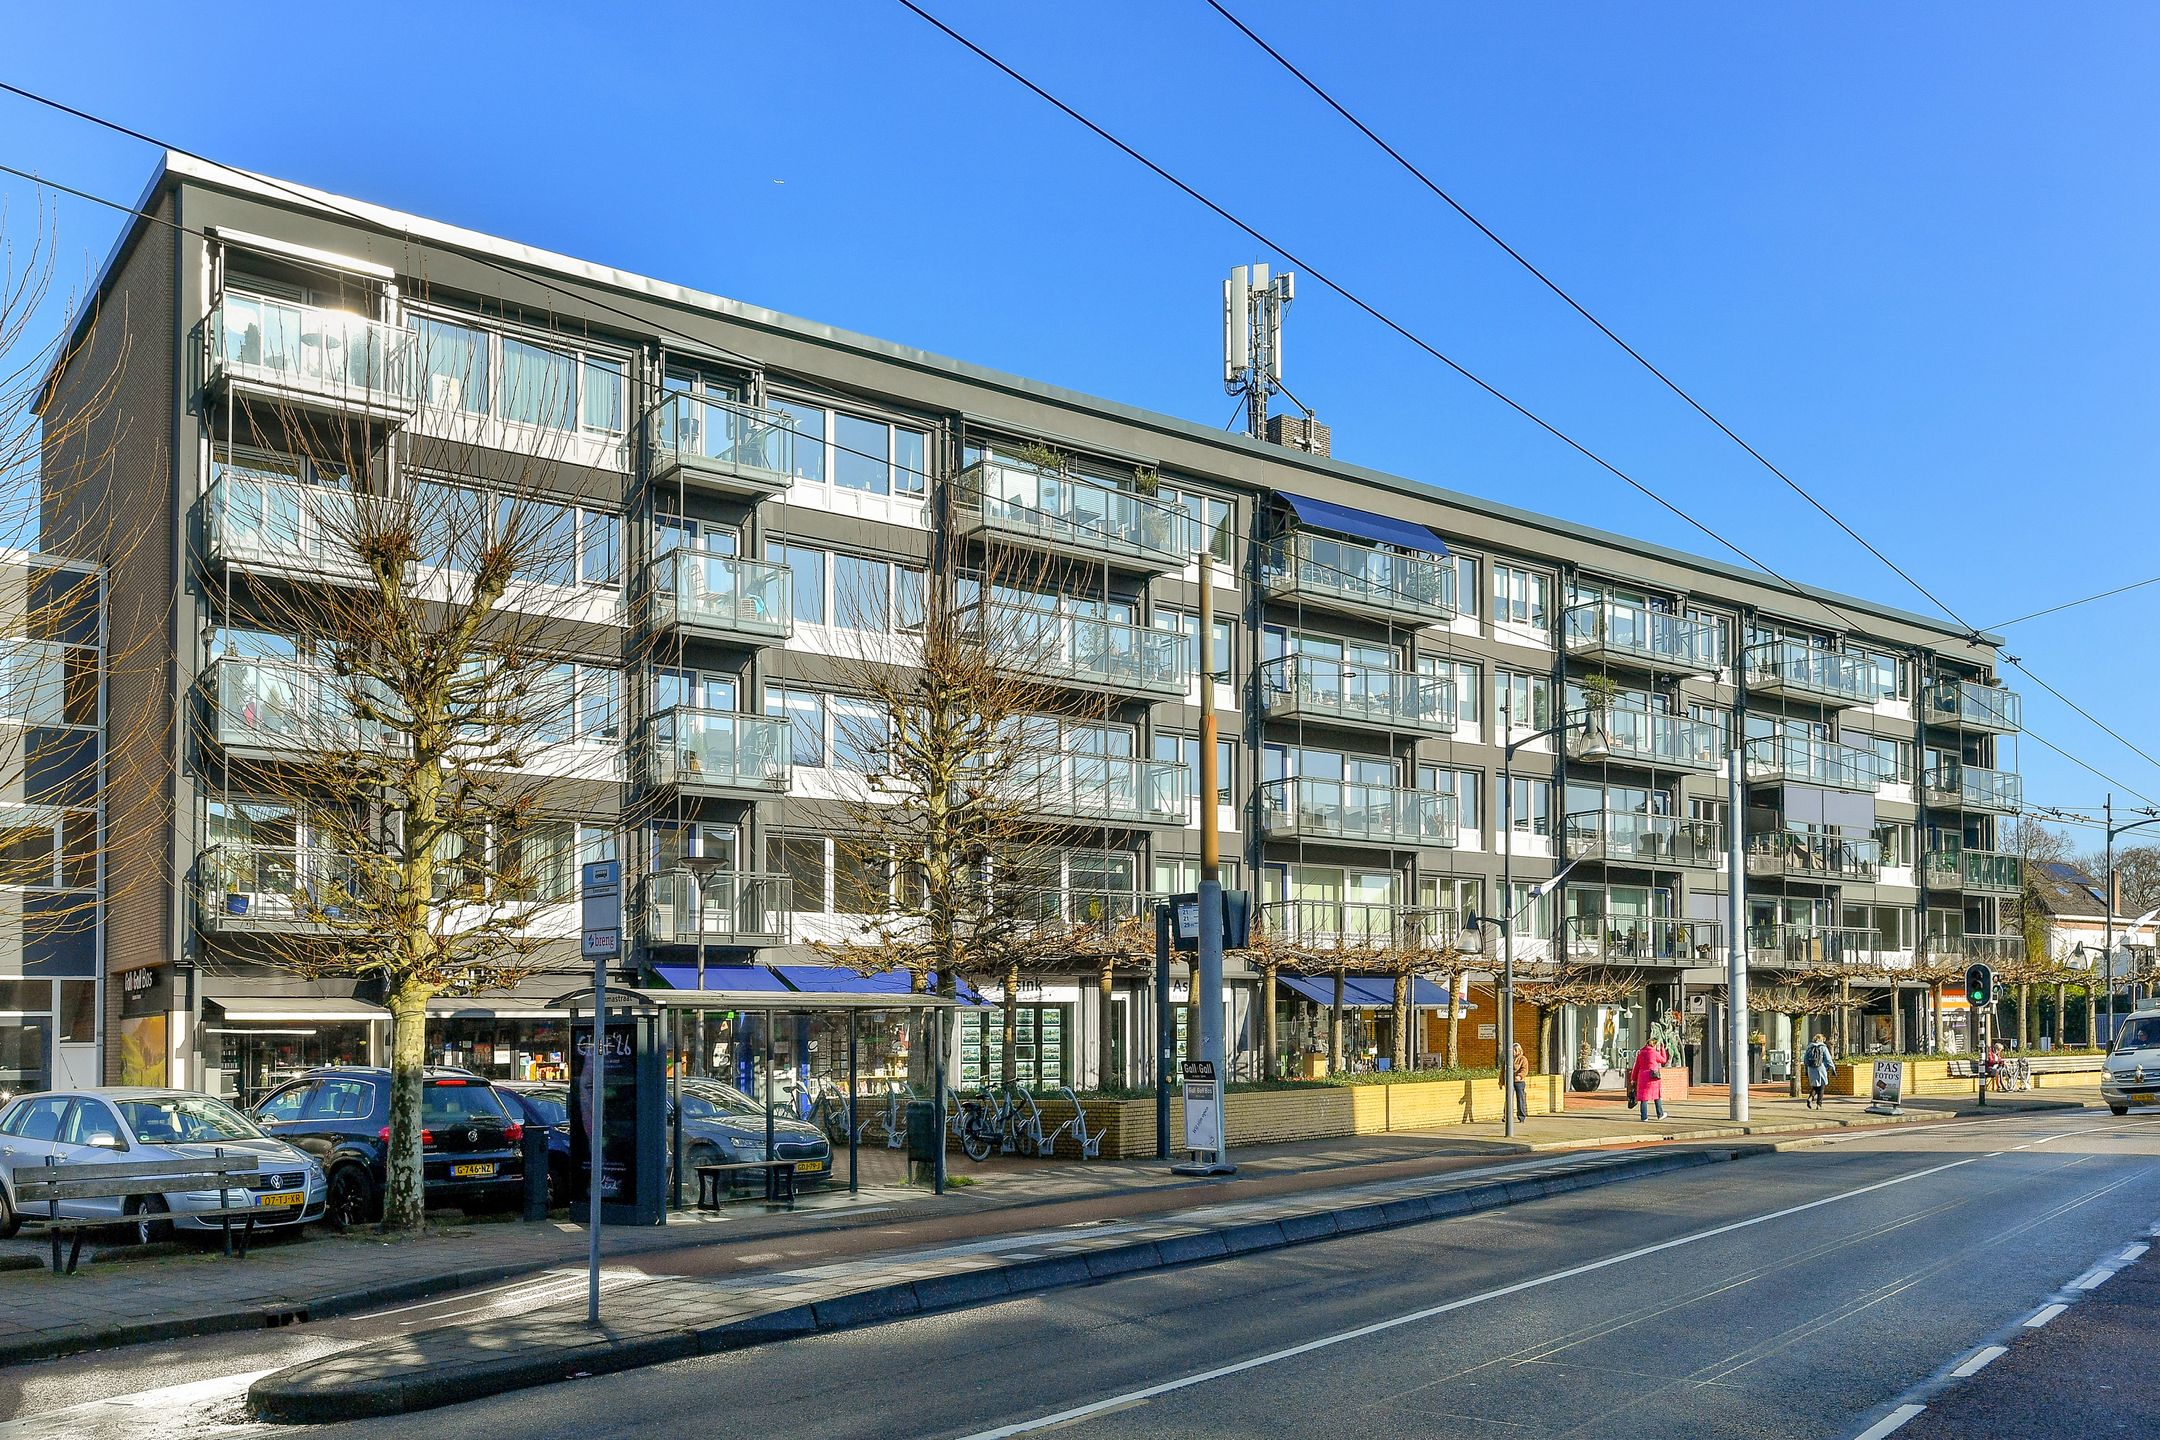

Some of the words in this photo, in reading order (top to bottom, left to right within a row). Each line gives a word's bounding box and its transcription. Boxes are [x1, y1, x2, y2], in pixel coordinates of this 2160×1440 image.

[594, 933, 614, 949] breng
[996, 976, 1042, 992] Asink
[1172, 979, 1188, 992] As
[604, 995, 632, 1003] mastraat
[1183, 1063, 1197, 1074] Gall
[1199, 1064, 1213, 1074] Gall
[1877, 1062, 1899, 1073] PAS
[1875, 1072, 1899, 1080] FOTO'S
[457, 1164, 491, 1174] G-746-NZ
[264, 1194, 301, 1206] 07-TJ-XR
